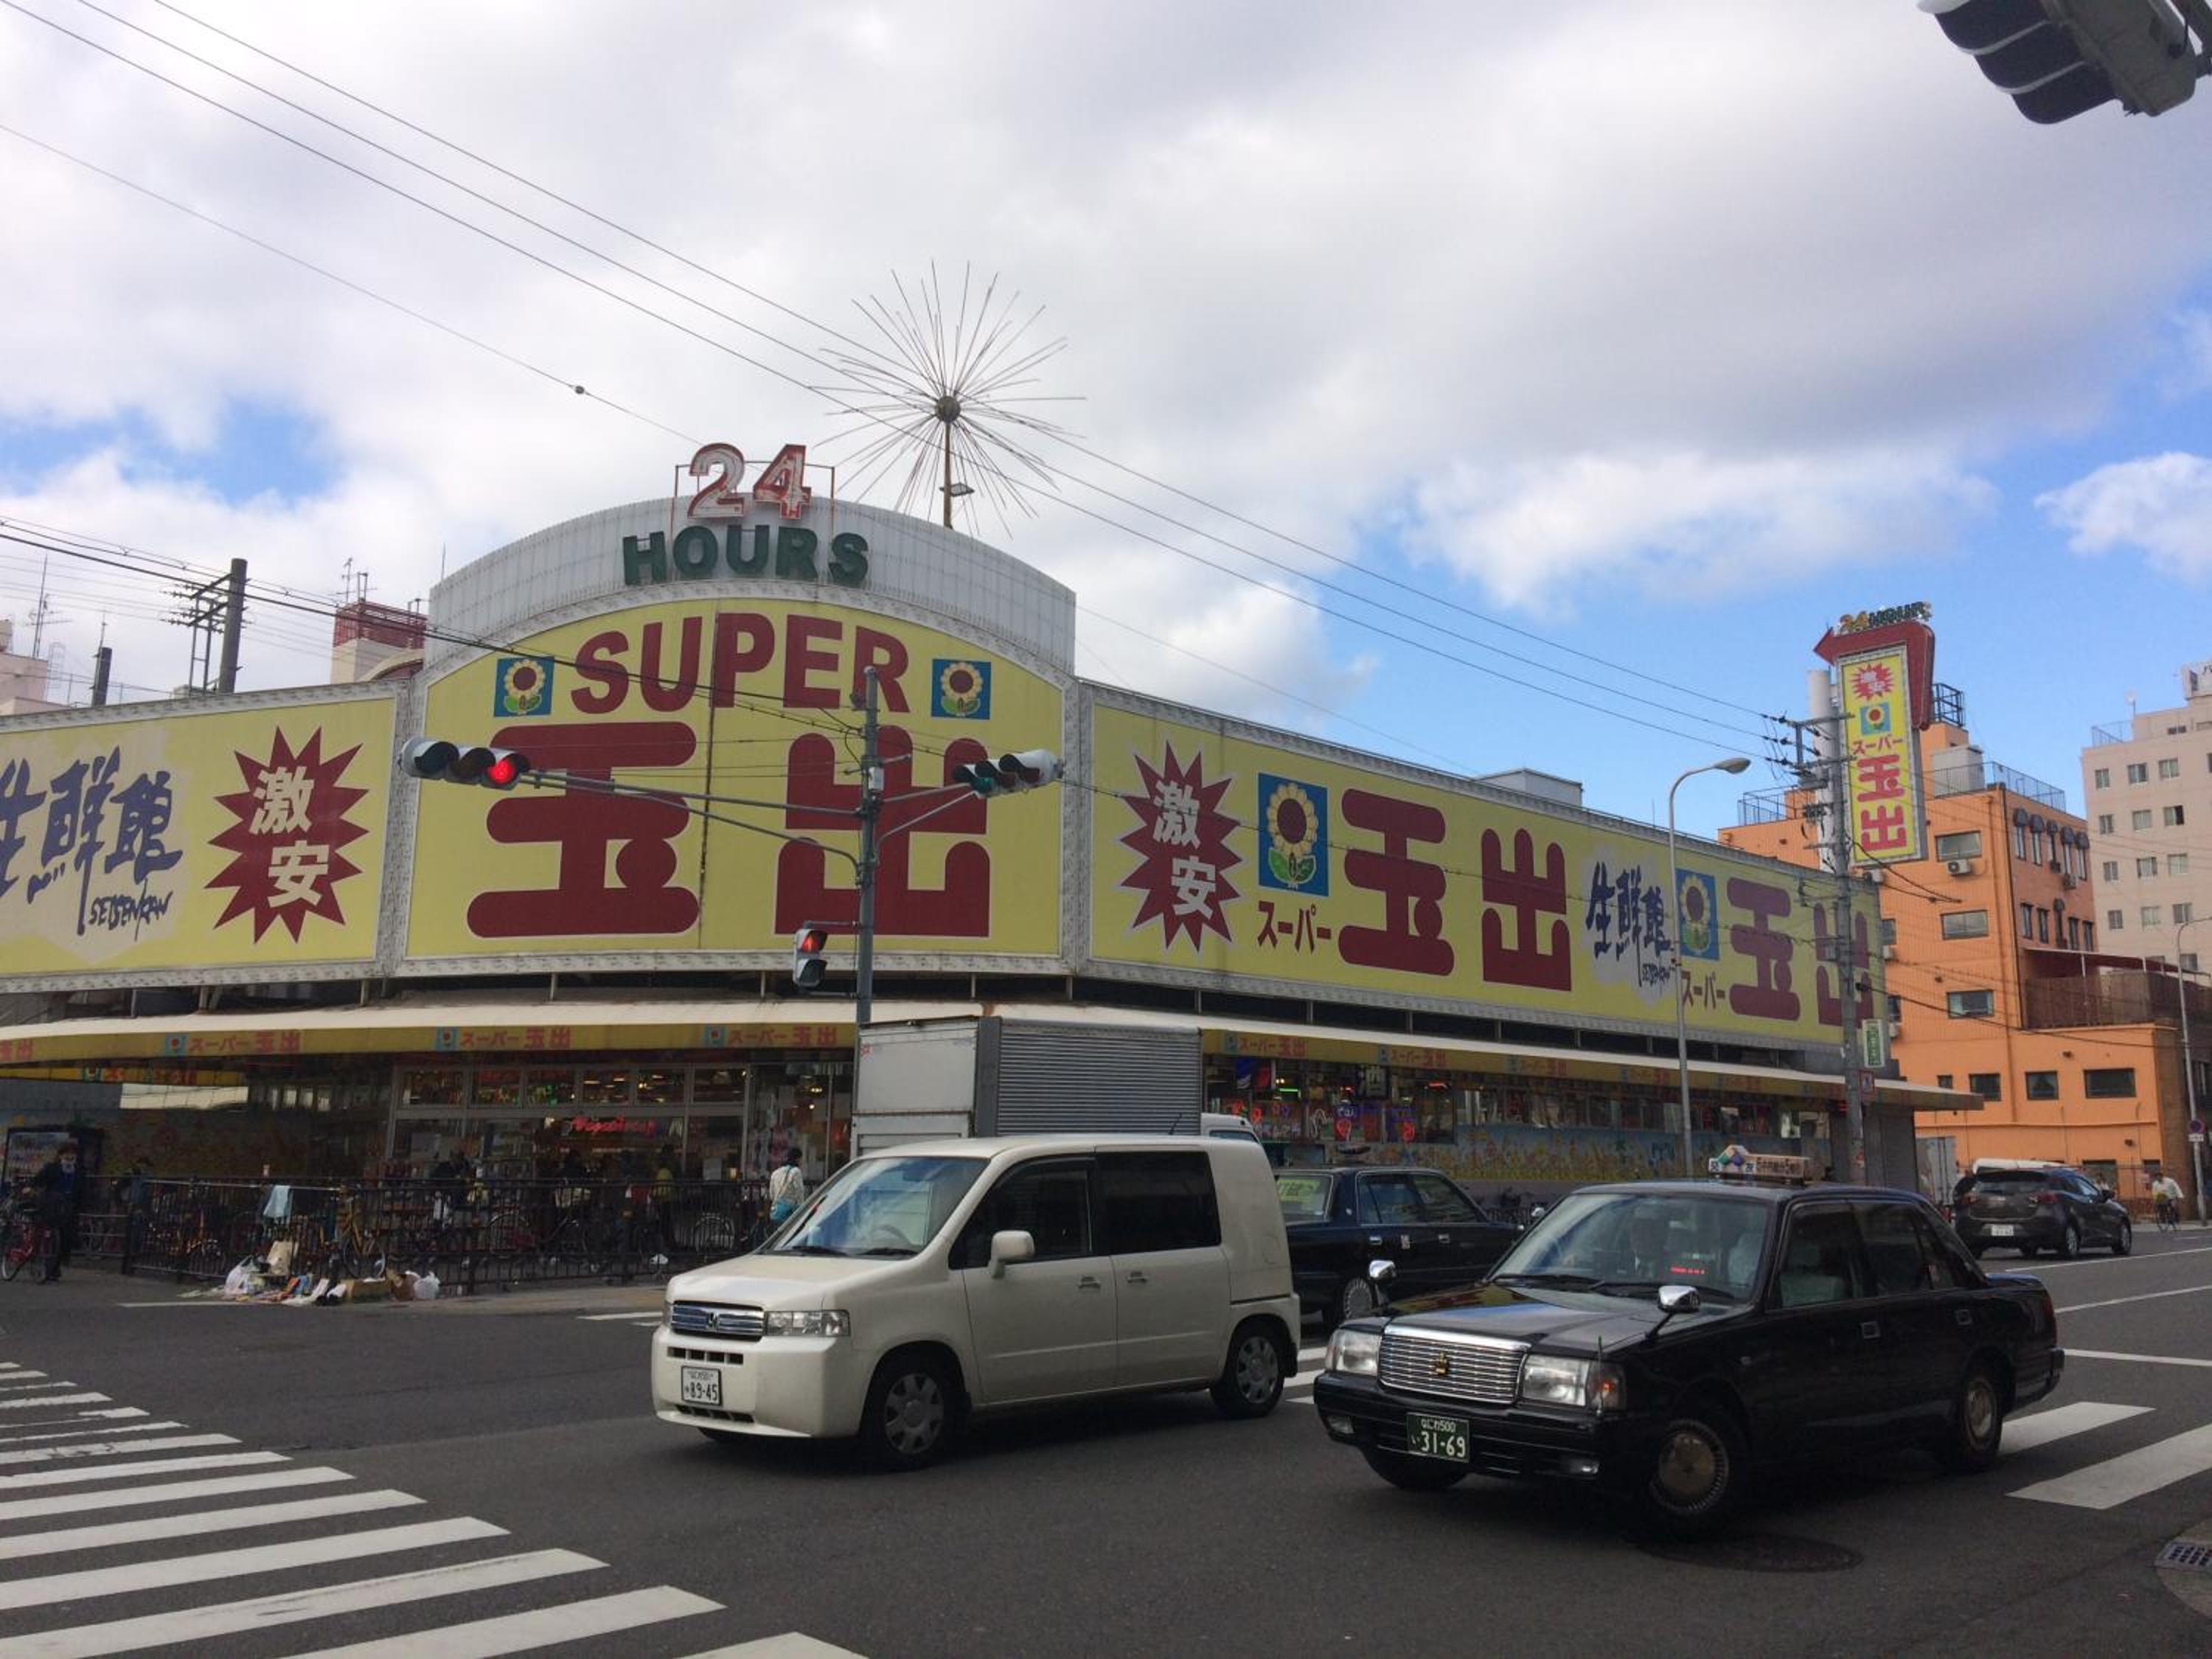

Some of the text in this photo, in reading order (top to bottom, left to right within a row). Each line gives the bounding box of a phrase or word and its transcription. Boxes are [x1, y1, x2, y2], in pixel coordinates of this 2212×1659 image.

[689, 442, 812, 521] 24
[622, 524, 869, 585] HOURS
[570, 611, 911, 714] SUPER
[1852, 734, 1903, 755] スーパー
[248, 766, 330, 908] 激安
[467, 720, 991, 938] 玉出
[1857, 754, 1907, 851] 玉出
[1153, 781, 1215, 919] 激安
[1338, 788, 1571, 992] 玉出
[1257, 900, 1332, 953] スーパー
[1682, 970, 1725, 1009] スーパー
[1421, 1431, 1466, 1458] 31-69
